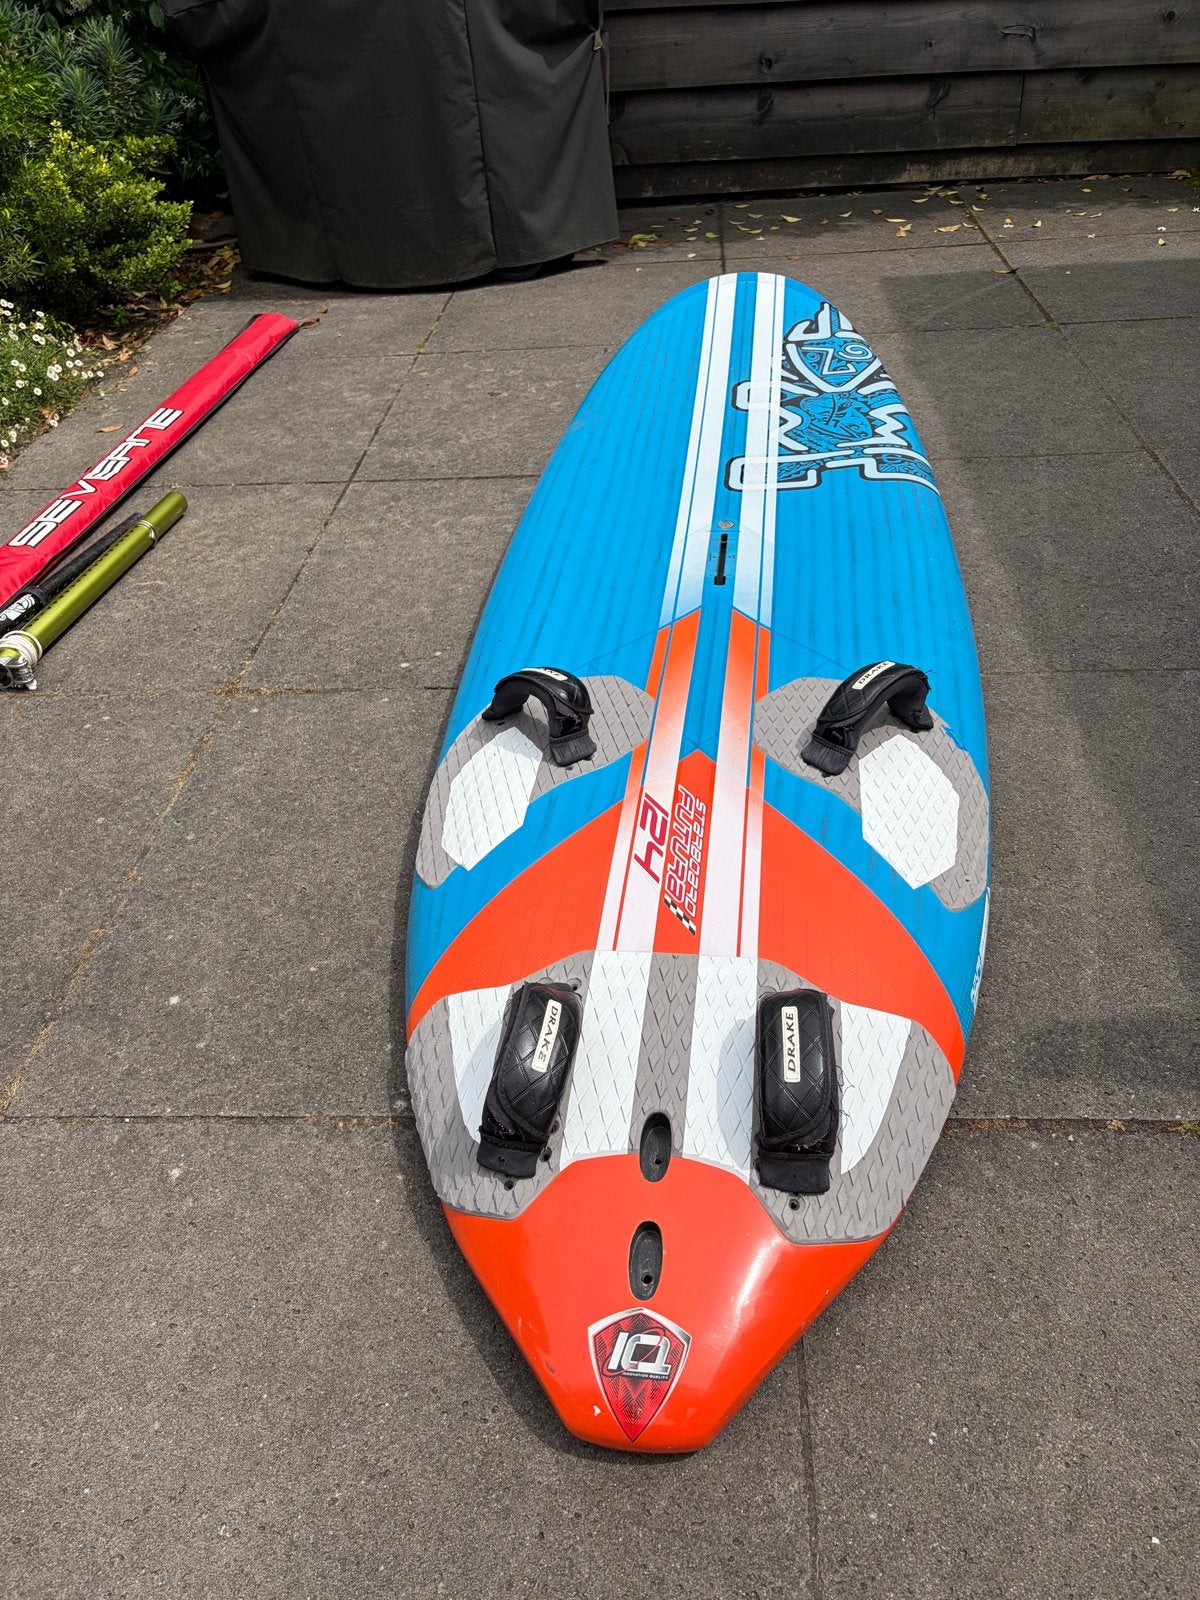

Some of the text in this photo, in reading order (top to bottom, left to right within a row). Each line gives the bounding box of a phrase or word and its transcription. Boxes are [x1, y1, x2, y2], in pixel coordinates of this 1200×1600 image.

[7, 407, 184, 547] SEVERNE
[858, 662, 889, 685] DRAKE
[633, 792, 670, 885] 124
[664, 783, 695, 903] FUTURA
[684, 797, 707, 918] STARBOARD
[536, 1005, 559, 1065] DRAKE
[786, 1011, 796, 1073] DRAKE
[607, 1331, 672, 1376] IQ
